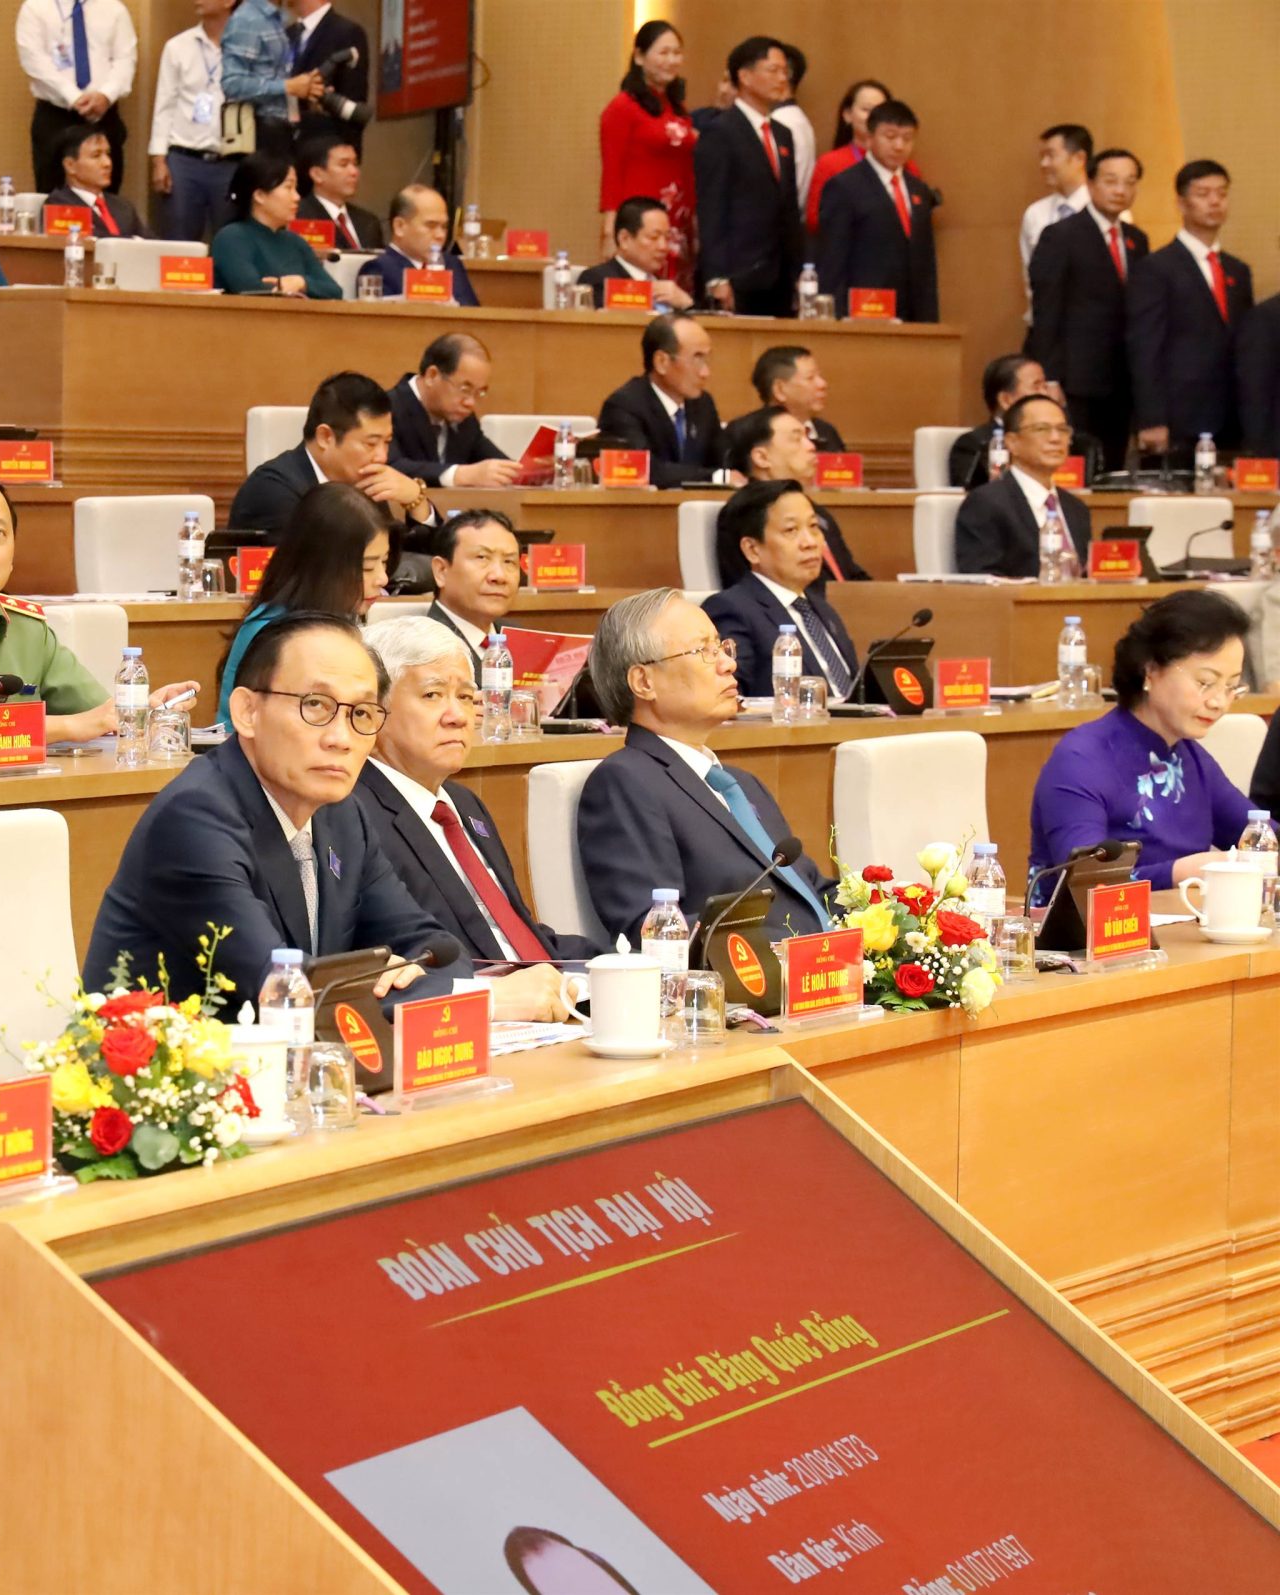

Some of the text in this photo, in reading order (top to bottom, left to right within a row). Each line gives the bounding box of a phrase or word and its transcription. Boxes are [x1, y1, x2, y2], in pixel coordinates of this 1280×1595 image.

[13, 734, 32, 749] HƯNG
[802, 969, 849, 993] LÊ HOÀI TRUNG
[417, 1046, 432, 1071] ĐÀO
[376, 1171, 714, 1301] ĐOÀN CHỦ TỊCH ĐẠI HỘI
[595, 1310, 879, 1428] Đồng chí: Đặng Quốc Đồng
[702, 1434, 880, 1525] Ngày sinh: 20/08/1973
[767, 1519, 885, 1584] Dân tộc: Kinh
[945, 1534, 1035, 1592] 01/07/1997
